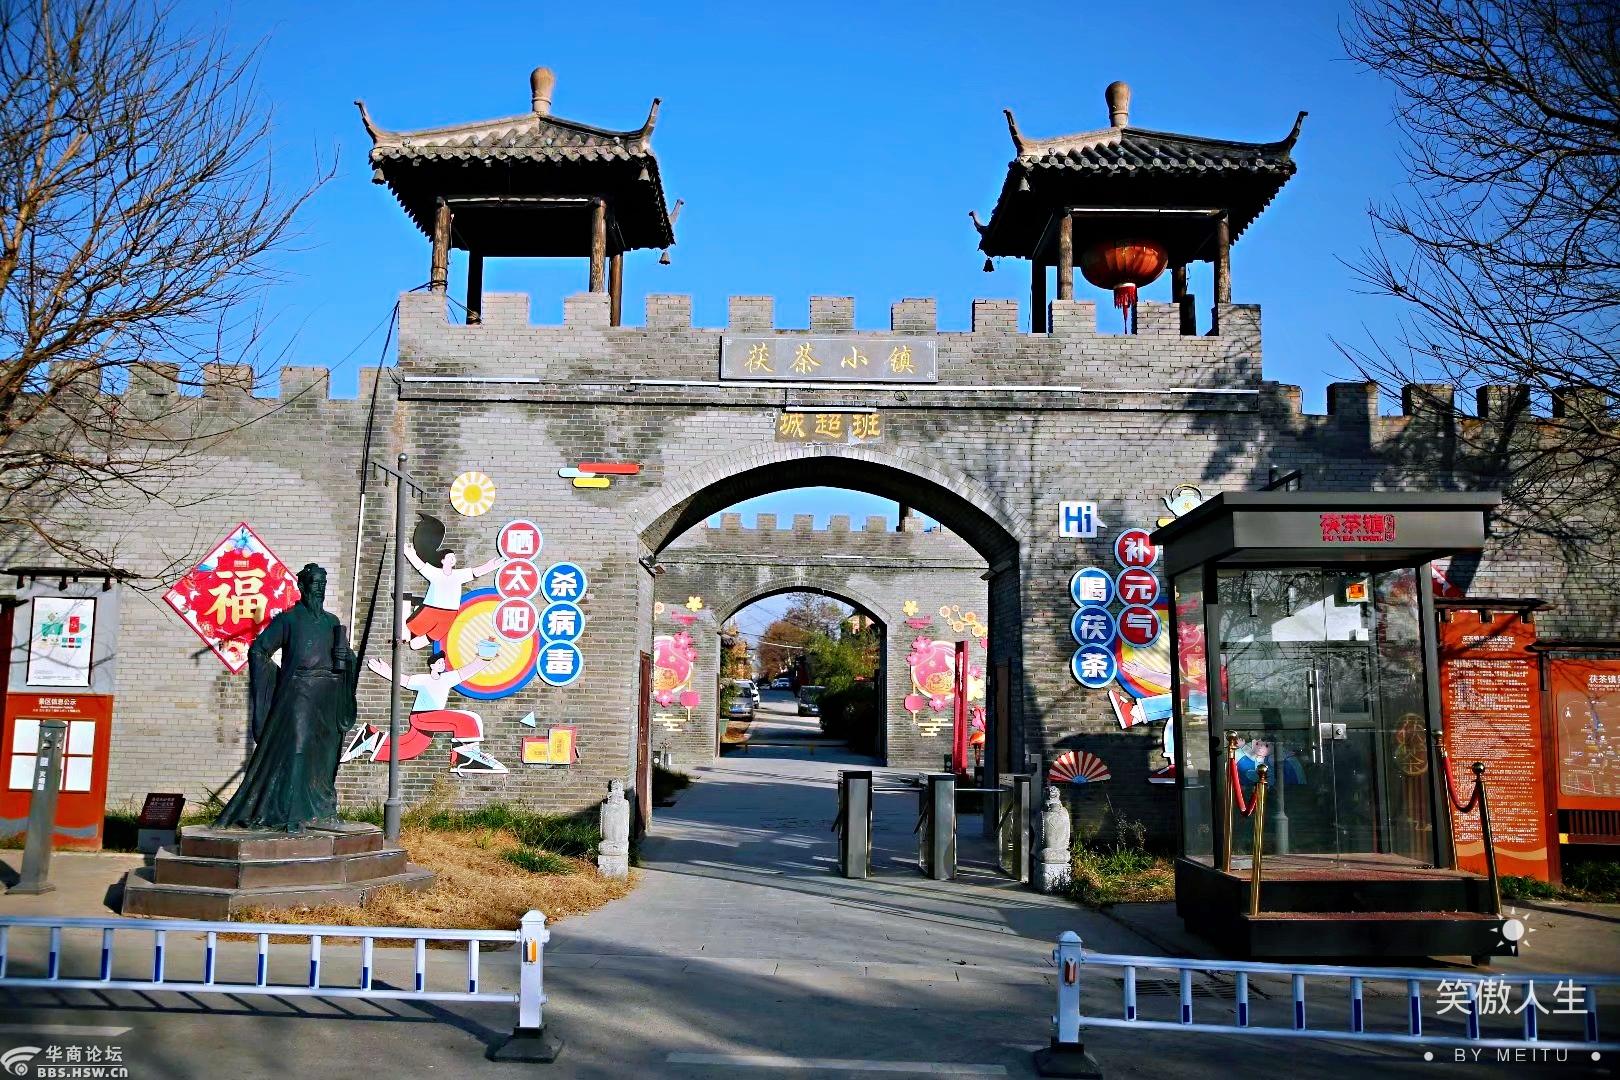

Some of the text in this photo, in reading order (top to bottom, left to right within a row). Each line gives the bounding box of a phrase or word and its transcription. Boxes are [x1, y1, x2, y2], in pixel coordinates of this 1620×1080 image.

[744, 342, 917, 374] 茯茶小镇
[1065, 505, 1092, 533] Hi
[1320, 514, 1384, 534] 茯茶镇
[204, 568, 269, 625] 福
[501, 529, 535, 633] 晒太阳
[1124, 537, 1153, 639] 补元气
[545, 571, 578, 675] 杀病毒
[1079, 576, 1108, 679] 喝茯茶
